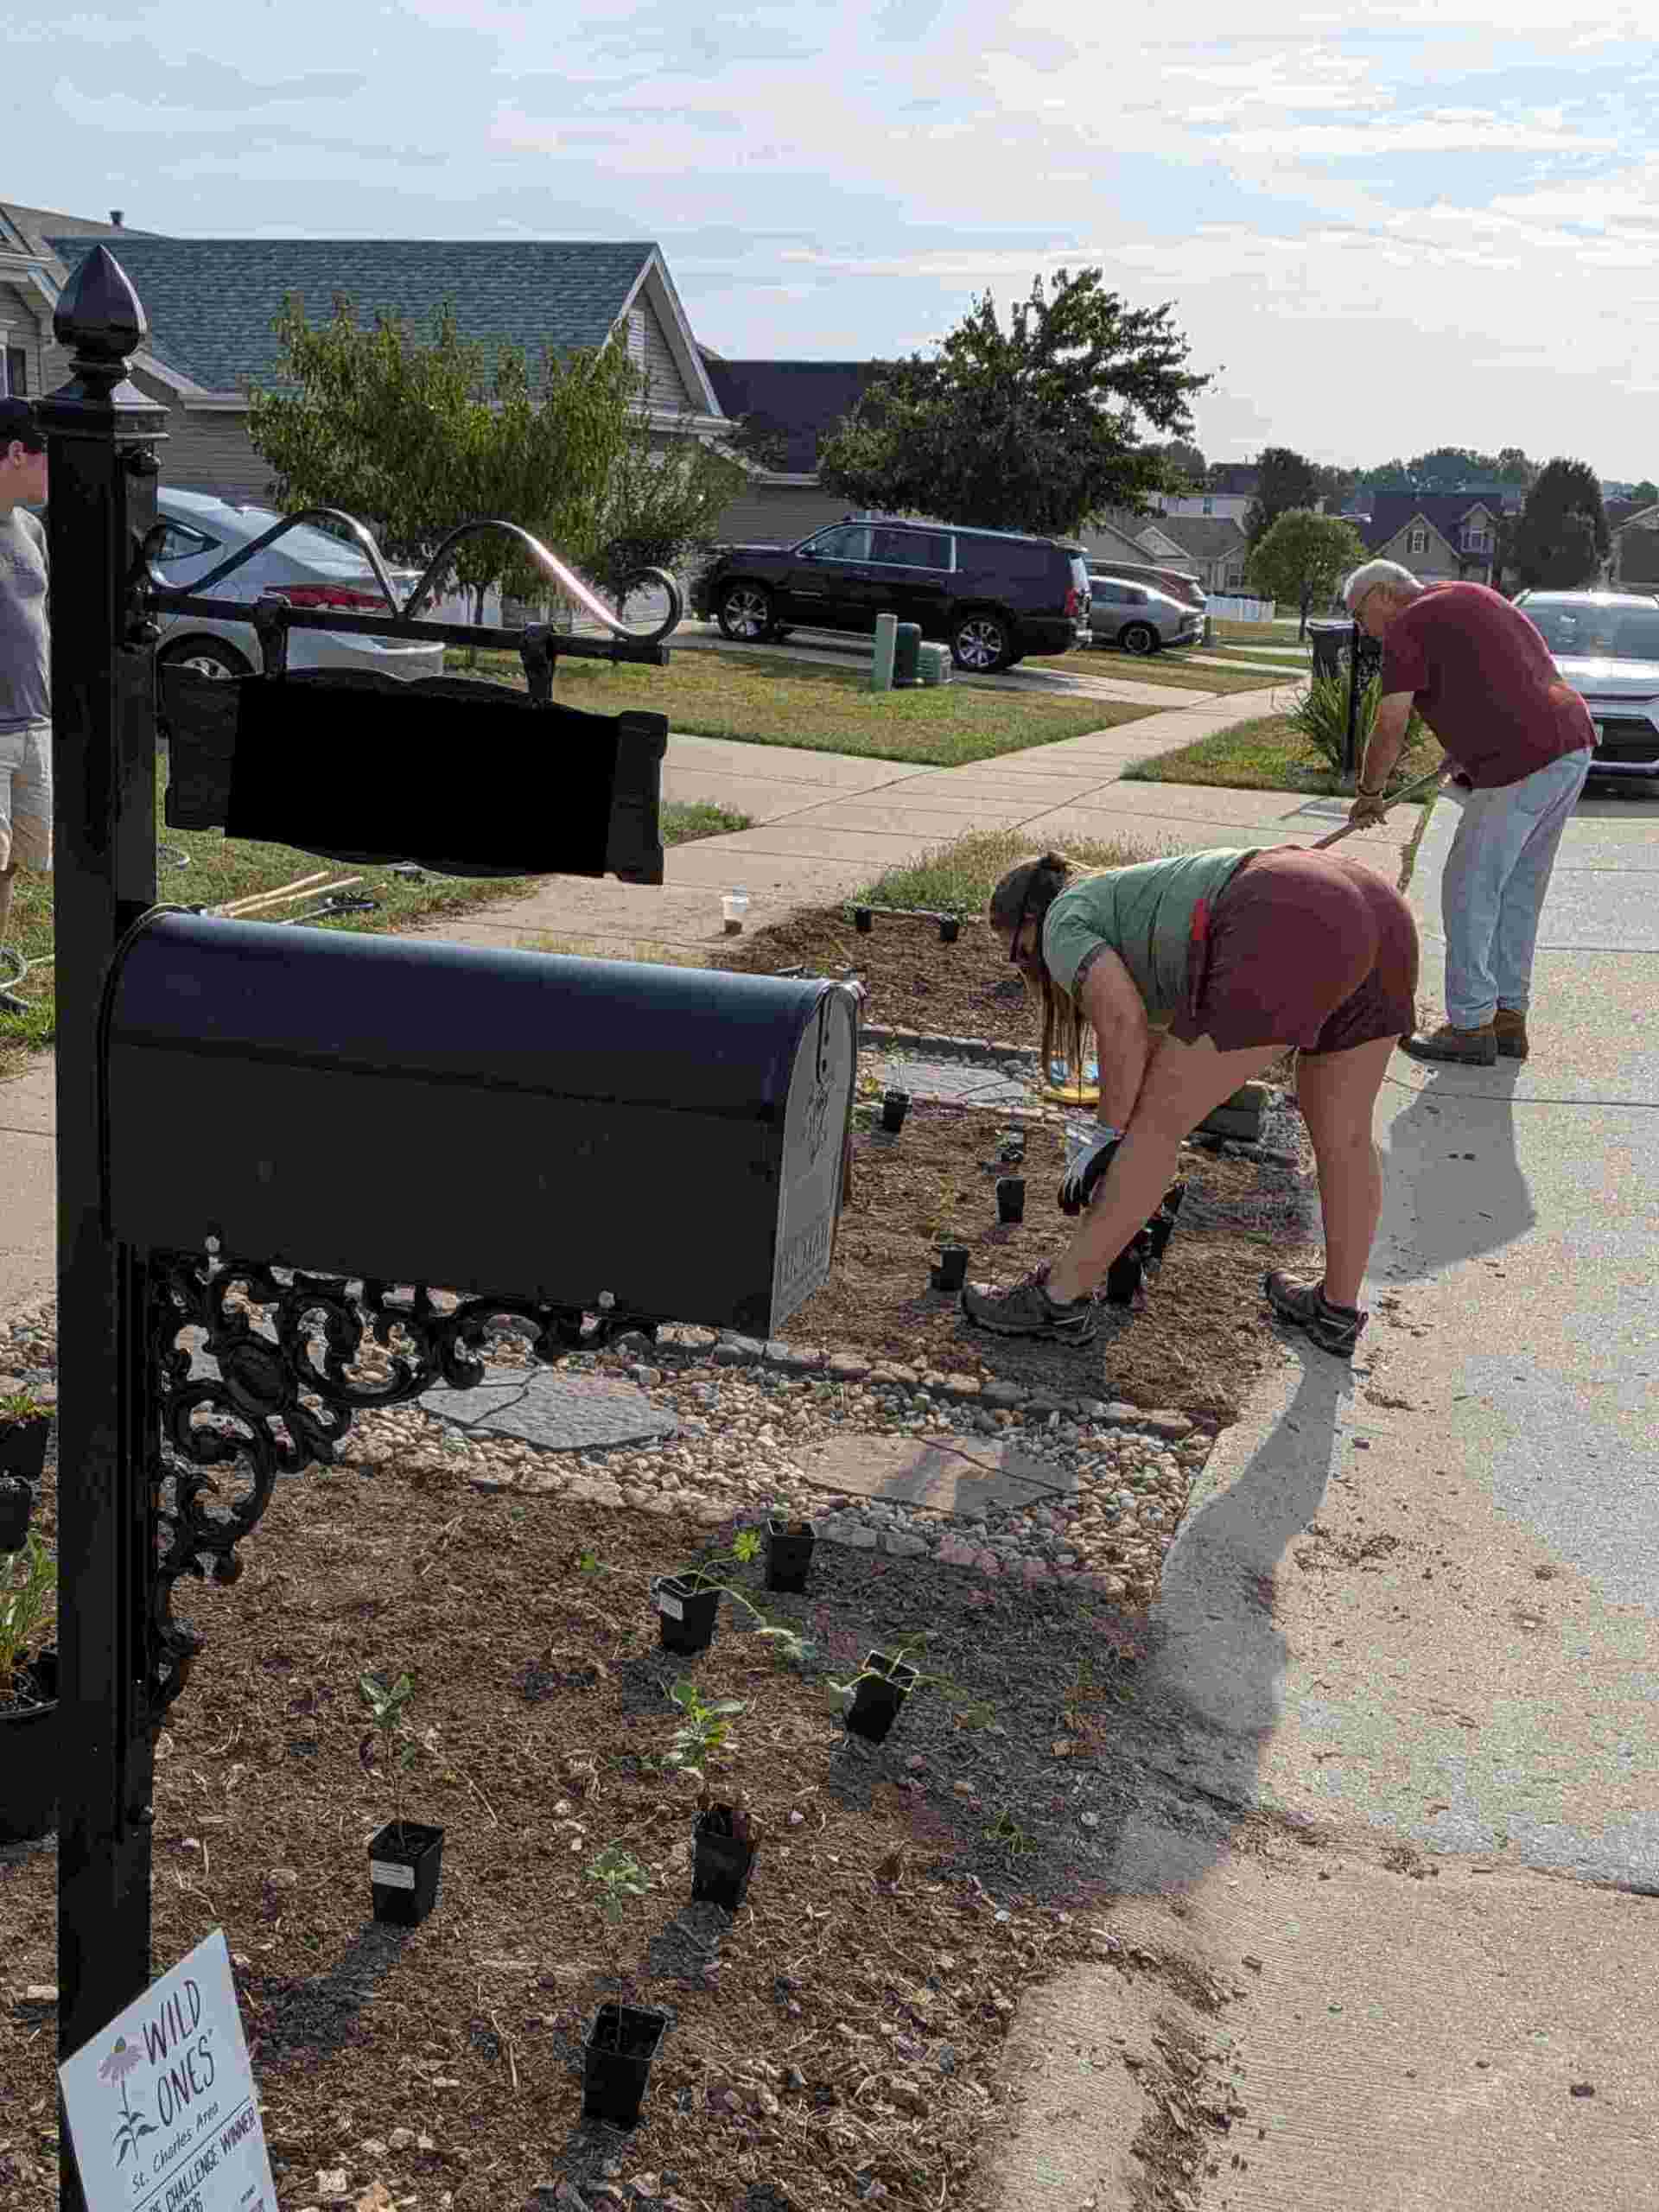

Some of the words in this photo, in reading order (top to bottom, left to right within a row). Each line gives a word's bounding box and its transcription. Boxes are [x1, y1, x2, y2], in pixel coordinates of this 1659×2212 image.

[143, 1980, 200, 2065] WILD
[157, 2034, 214, 2126] ONES
[132, 2171, 150, 2194] St.
[153, 2128, 193, 2173] Charles
[195, 2101, 219, 2133] Area
